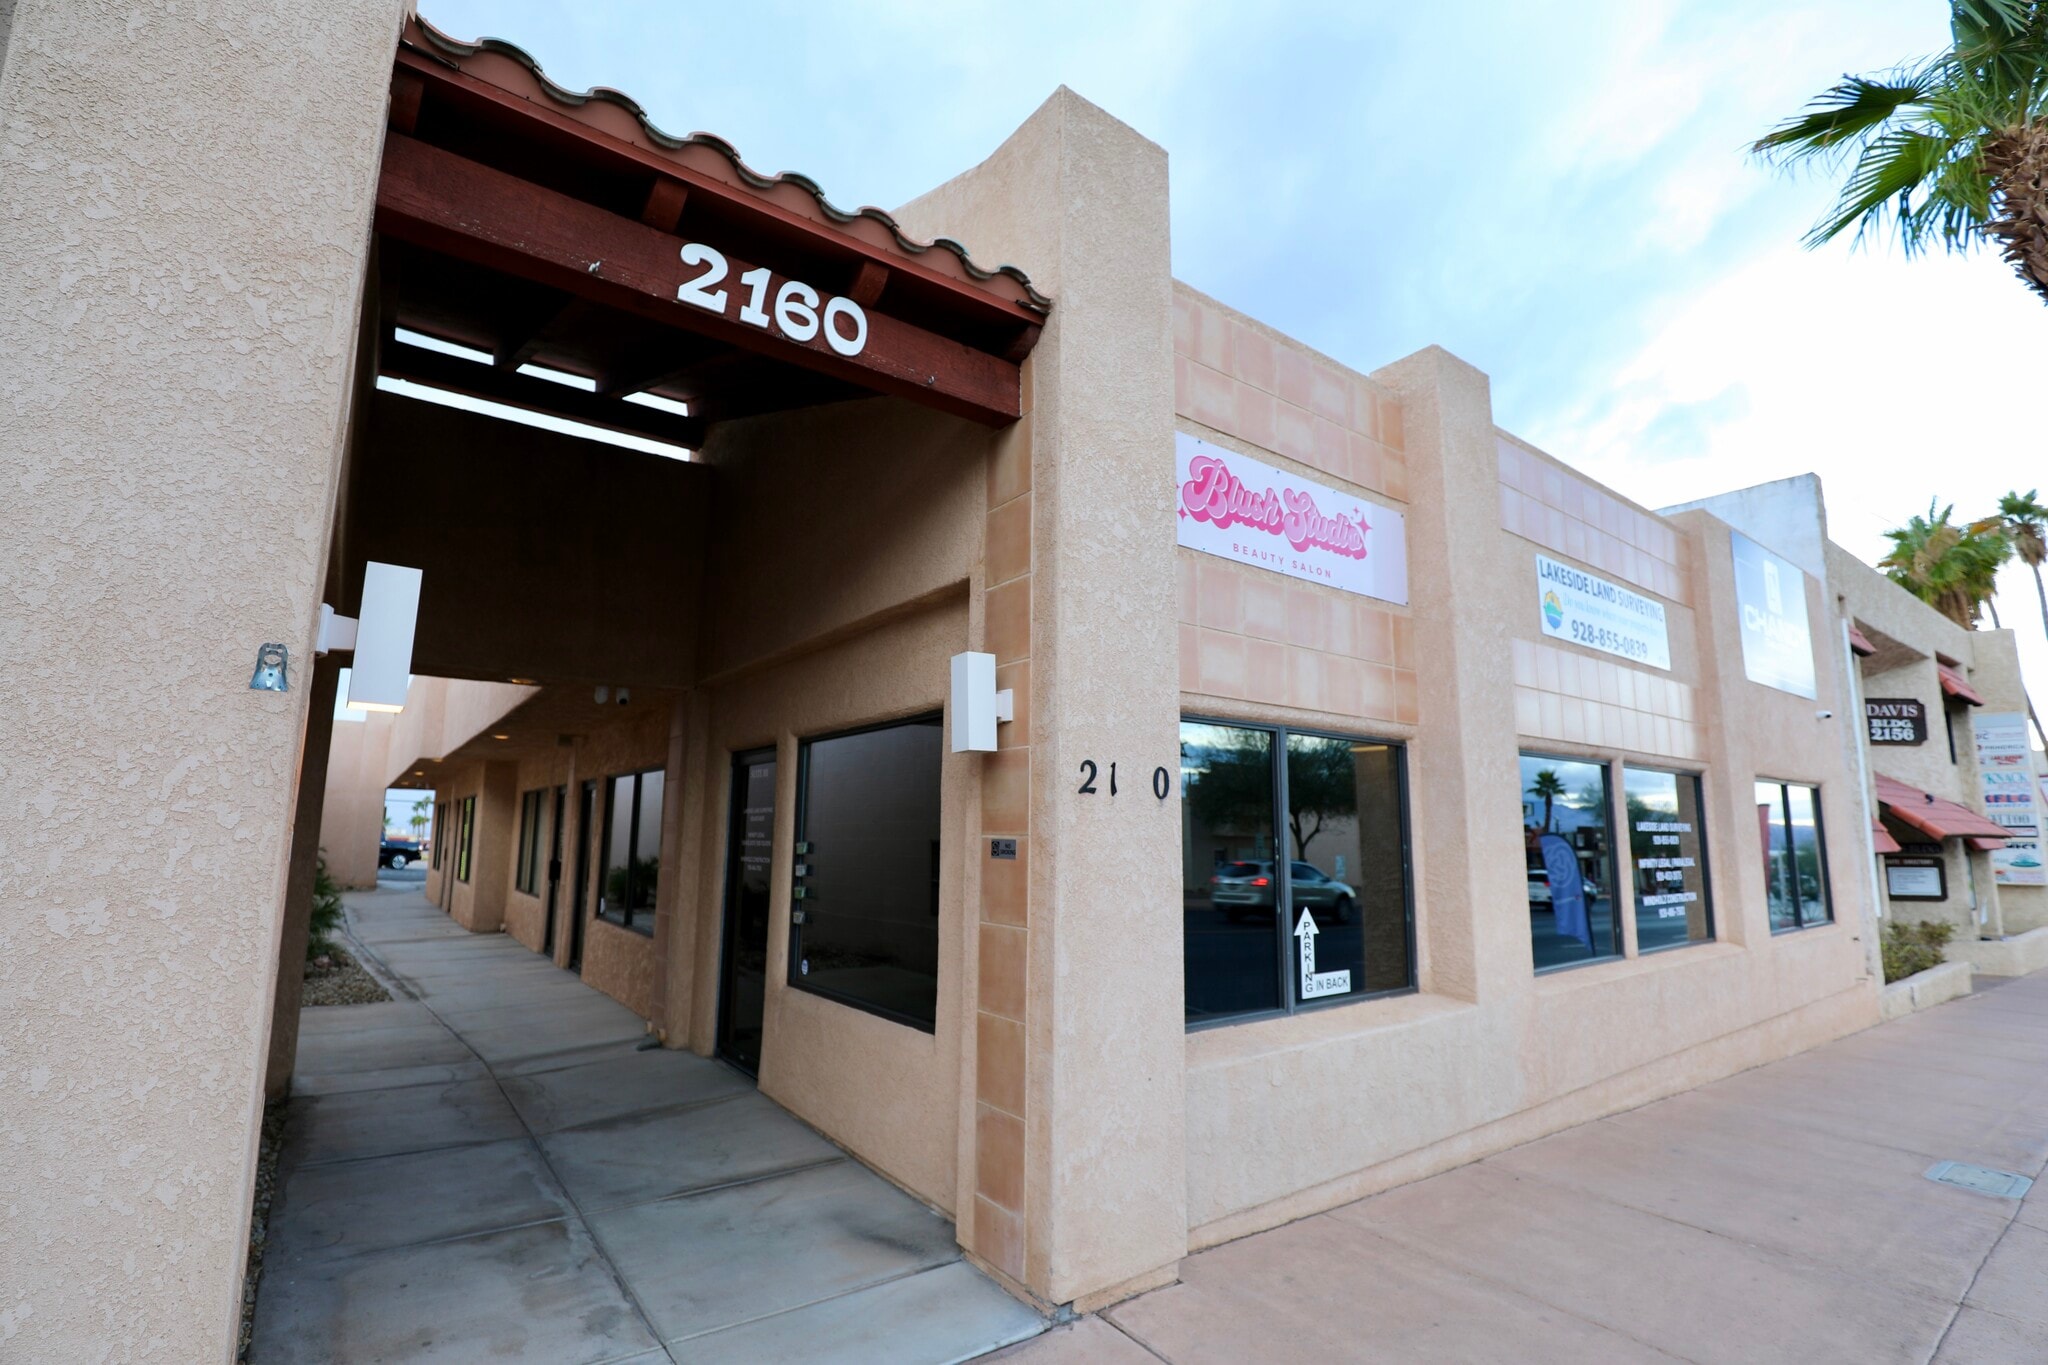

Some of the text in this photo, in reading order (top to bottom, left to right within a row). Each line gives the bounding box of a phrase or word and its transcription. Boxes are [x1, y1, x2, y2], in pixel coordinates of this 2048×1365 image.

[677, 242, 868, 357] 2160
[1182, 455, 1368, 561] Blush Studio
[1232, 543, 1333, 579] BEAUTY SALON
[1538, 559, 1590, 595] LAKESIDE
[1590, 578, 1618, 604] LAND
[1617, 590, 1665, 623] SURVEYING
[1571, 619, 1649, 660] 928-855-0839
[1866, 703, 1918, 718] DAVIS
[1870, 728, 1915, 742] 2156
[1303, 921, 1314, 993] PARKING
[1316, 976, 1348, 991] IN BACK
